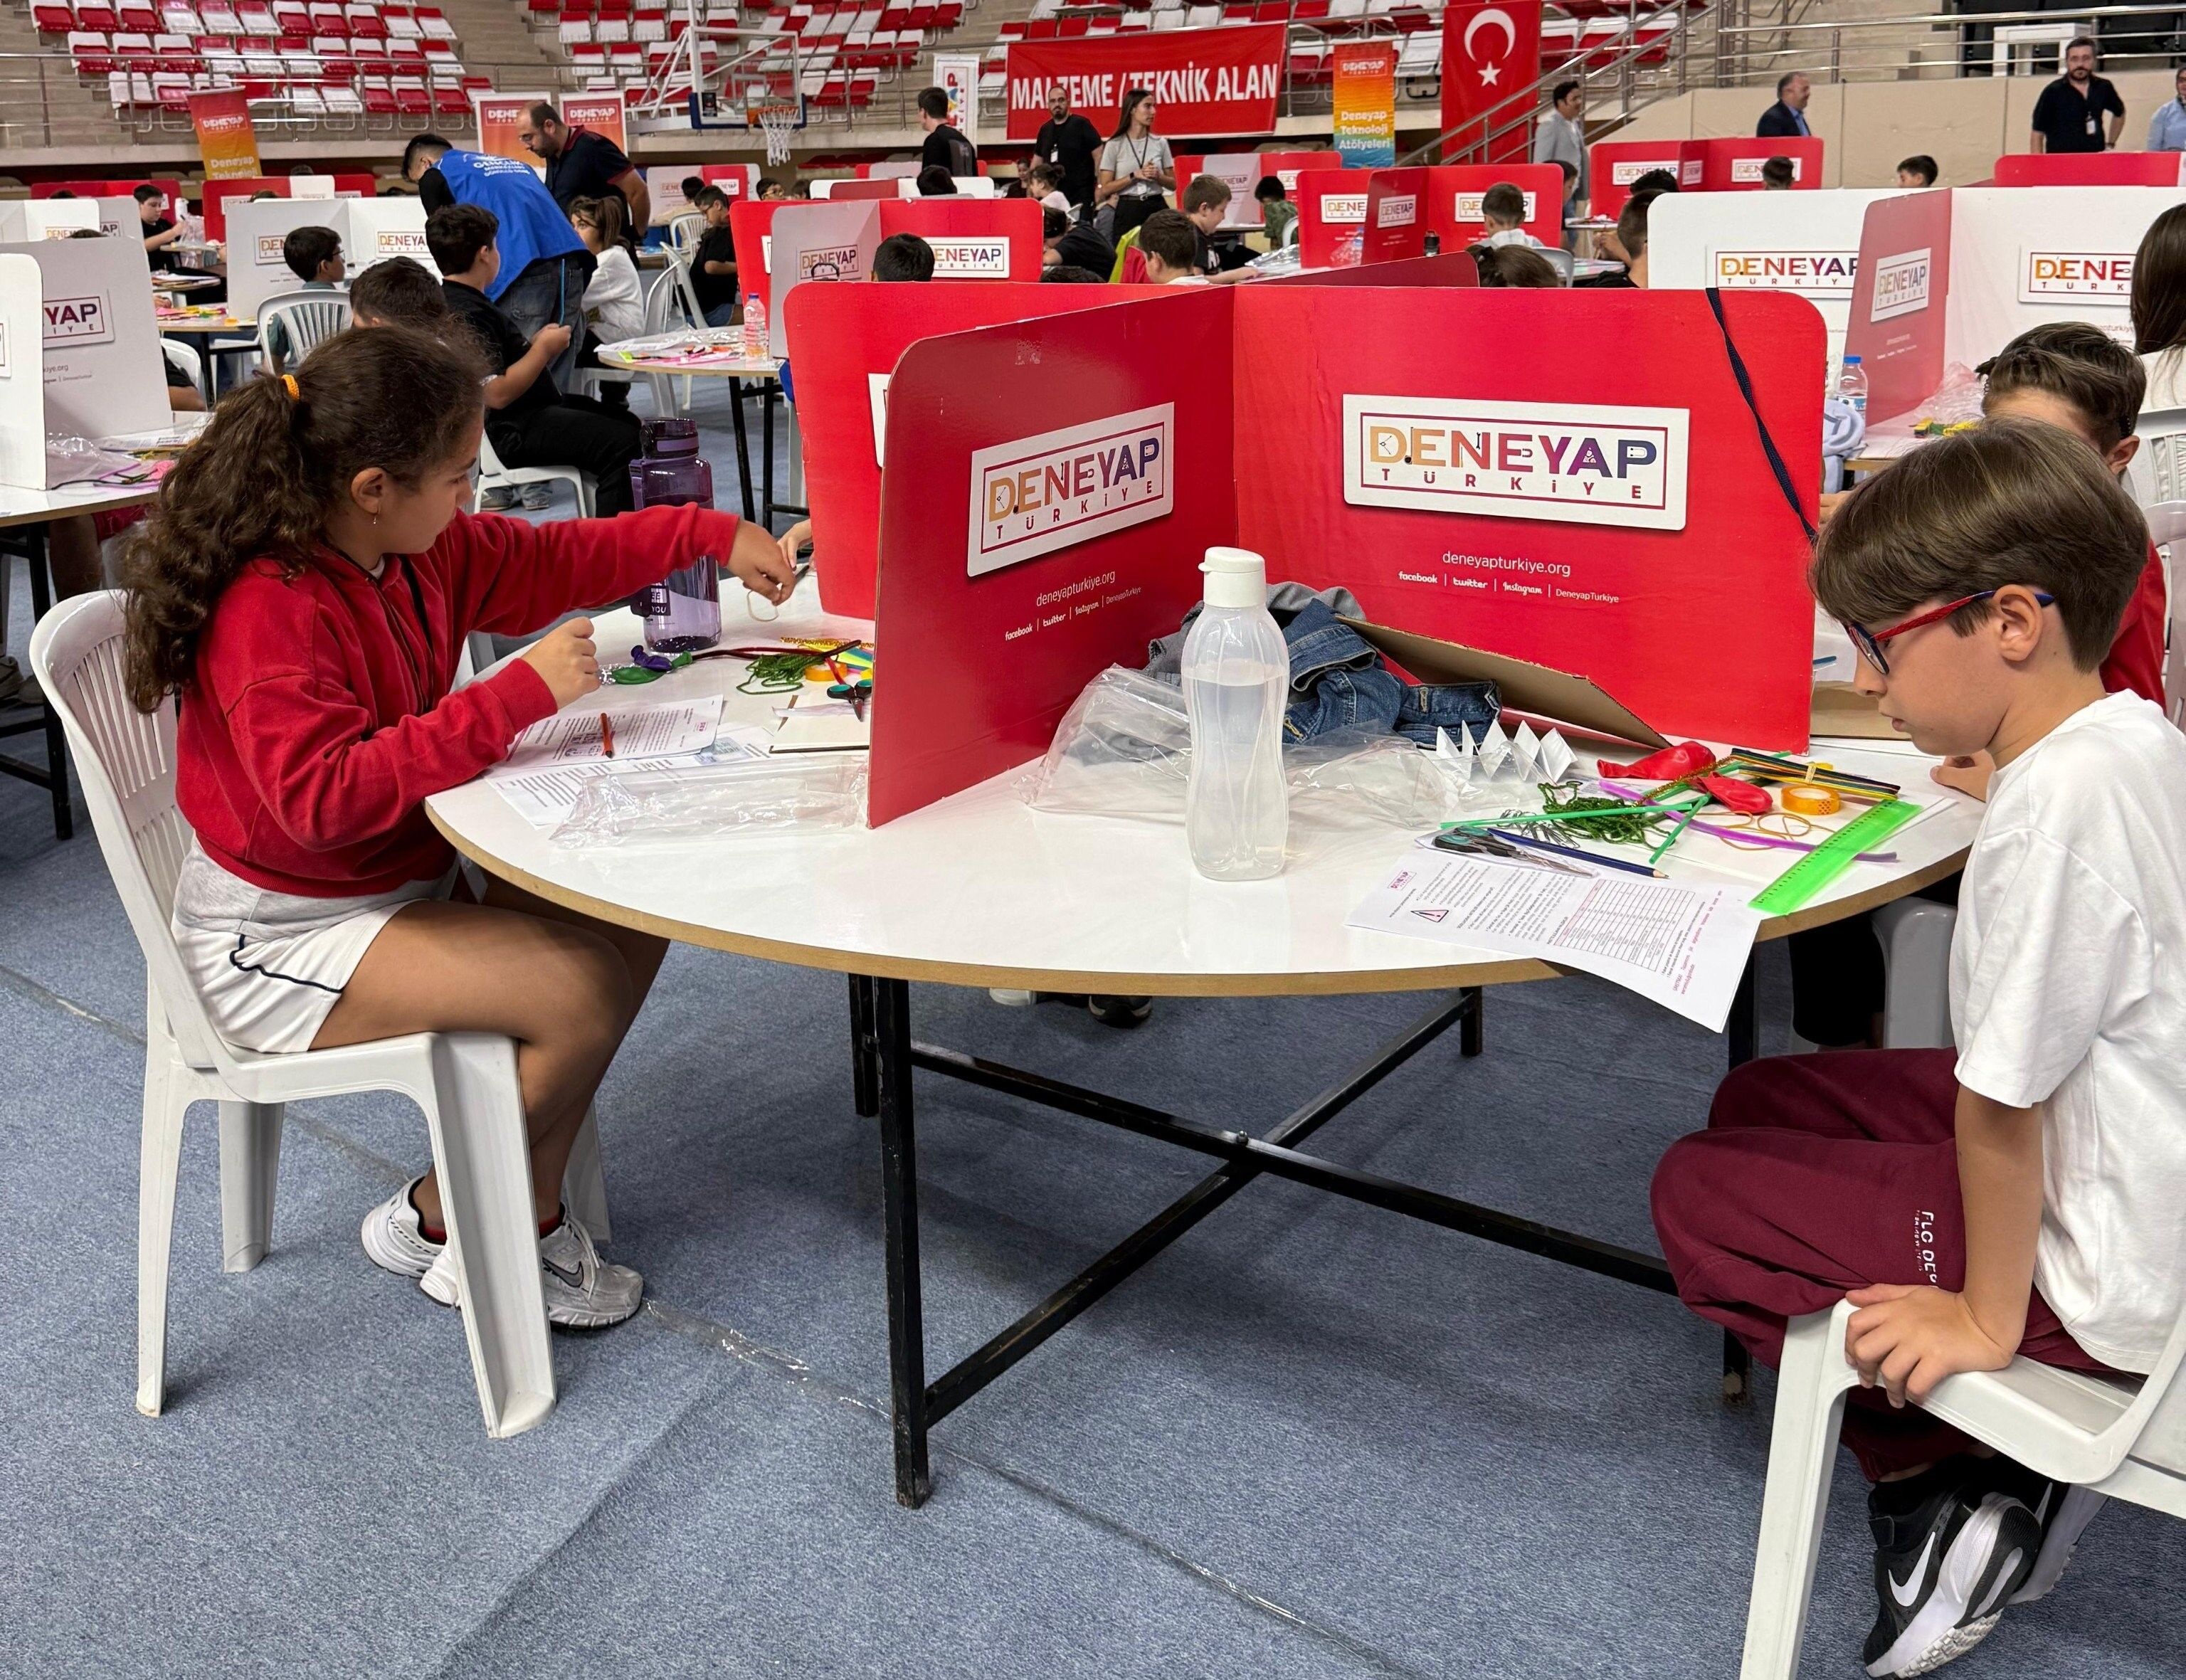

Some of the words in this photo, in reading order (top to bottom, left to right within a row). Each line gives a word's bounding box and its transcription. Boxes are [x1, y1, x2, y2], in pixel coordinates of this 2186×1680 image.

[1214, 63, 1278, 102] ALAN
[1340, 123, 1389, 135] Teknoloji
[1341, 110, 1387, 122] Deneyap
[1338, 138, 1390, 150] Atölyeleri
[1328, 201, 1366, 212] DENE
[379, 235, 426, 246] DENEYA
[934, 248, 1002, 263] ENEYAP
[1878, 265, 1926, 296] DENEYAP
[2035, 259, 2131, 281] DENE
[1369, 426, 1657, 480] DENEYAP
[988, 437, 1160, 523] DENEYAP
[1381, 467, 1642, 500] TÜRKİYE
[996, 480, 1152, 539] TÜRKİYE
[1442, 551, 1571, 577] deneyapturkiye.org
[1036, 570, 1116, 607] deneyapturkiye.org
[1398, 571, 1438, 584] facebook
[1452, 576, 1488, 589] twitter
[1501, 581, 1543, 596] Instagram
[1555, 588, 1620, 603] DeneyapTurkiye
[1005, 623, 1033, 641] facebook
[1042, 613, 1067, 628] twitter
[1074, 601, 1099, 616] Instagram
[1105, 586, 1142, 605] DeneyapTurkiye
